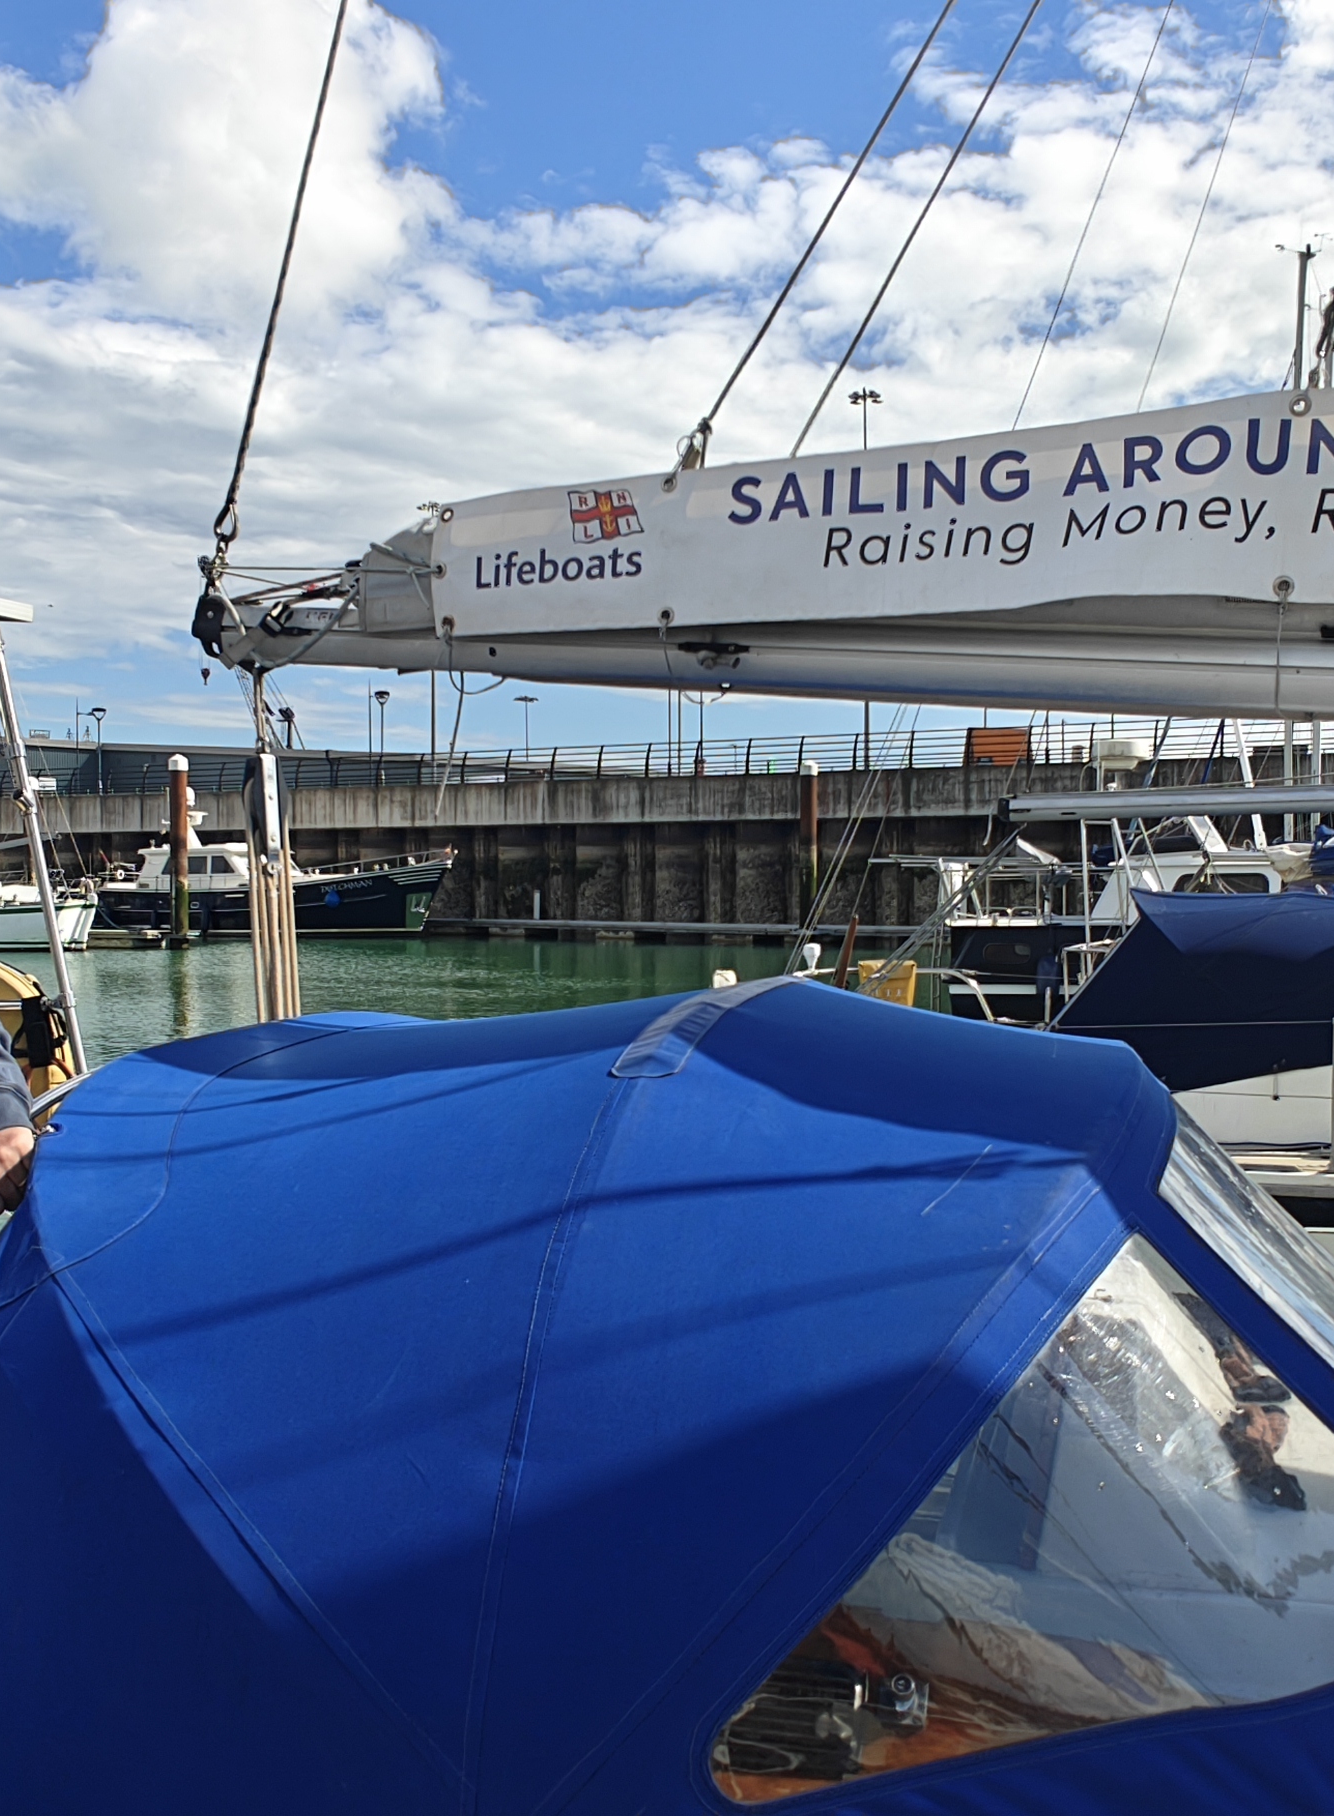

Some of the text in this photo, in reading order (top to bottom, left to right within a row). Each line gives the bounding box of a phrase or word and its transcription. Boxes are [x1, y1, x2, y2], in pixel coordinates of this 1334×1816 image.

[577, 491, 627, 508] R N
[727, 449, 1031, 526] SAILING
[583, 525, 594, 540] L
[822, 517, 1036, 569] Raising
[1061, 495, 1277, 548] Money,
[475, 546, 643, 590] Lifeboats
